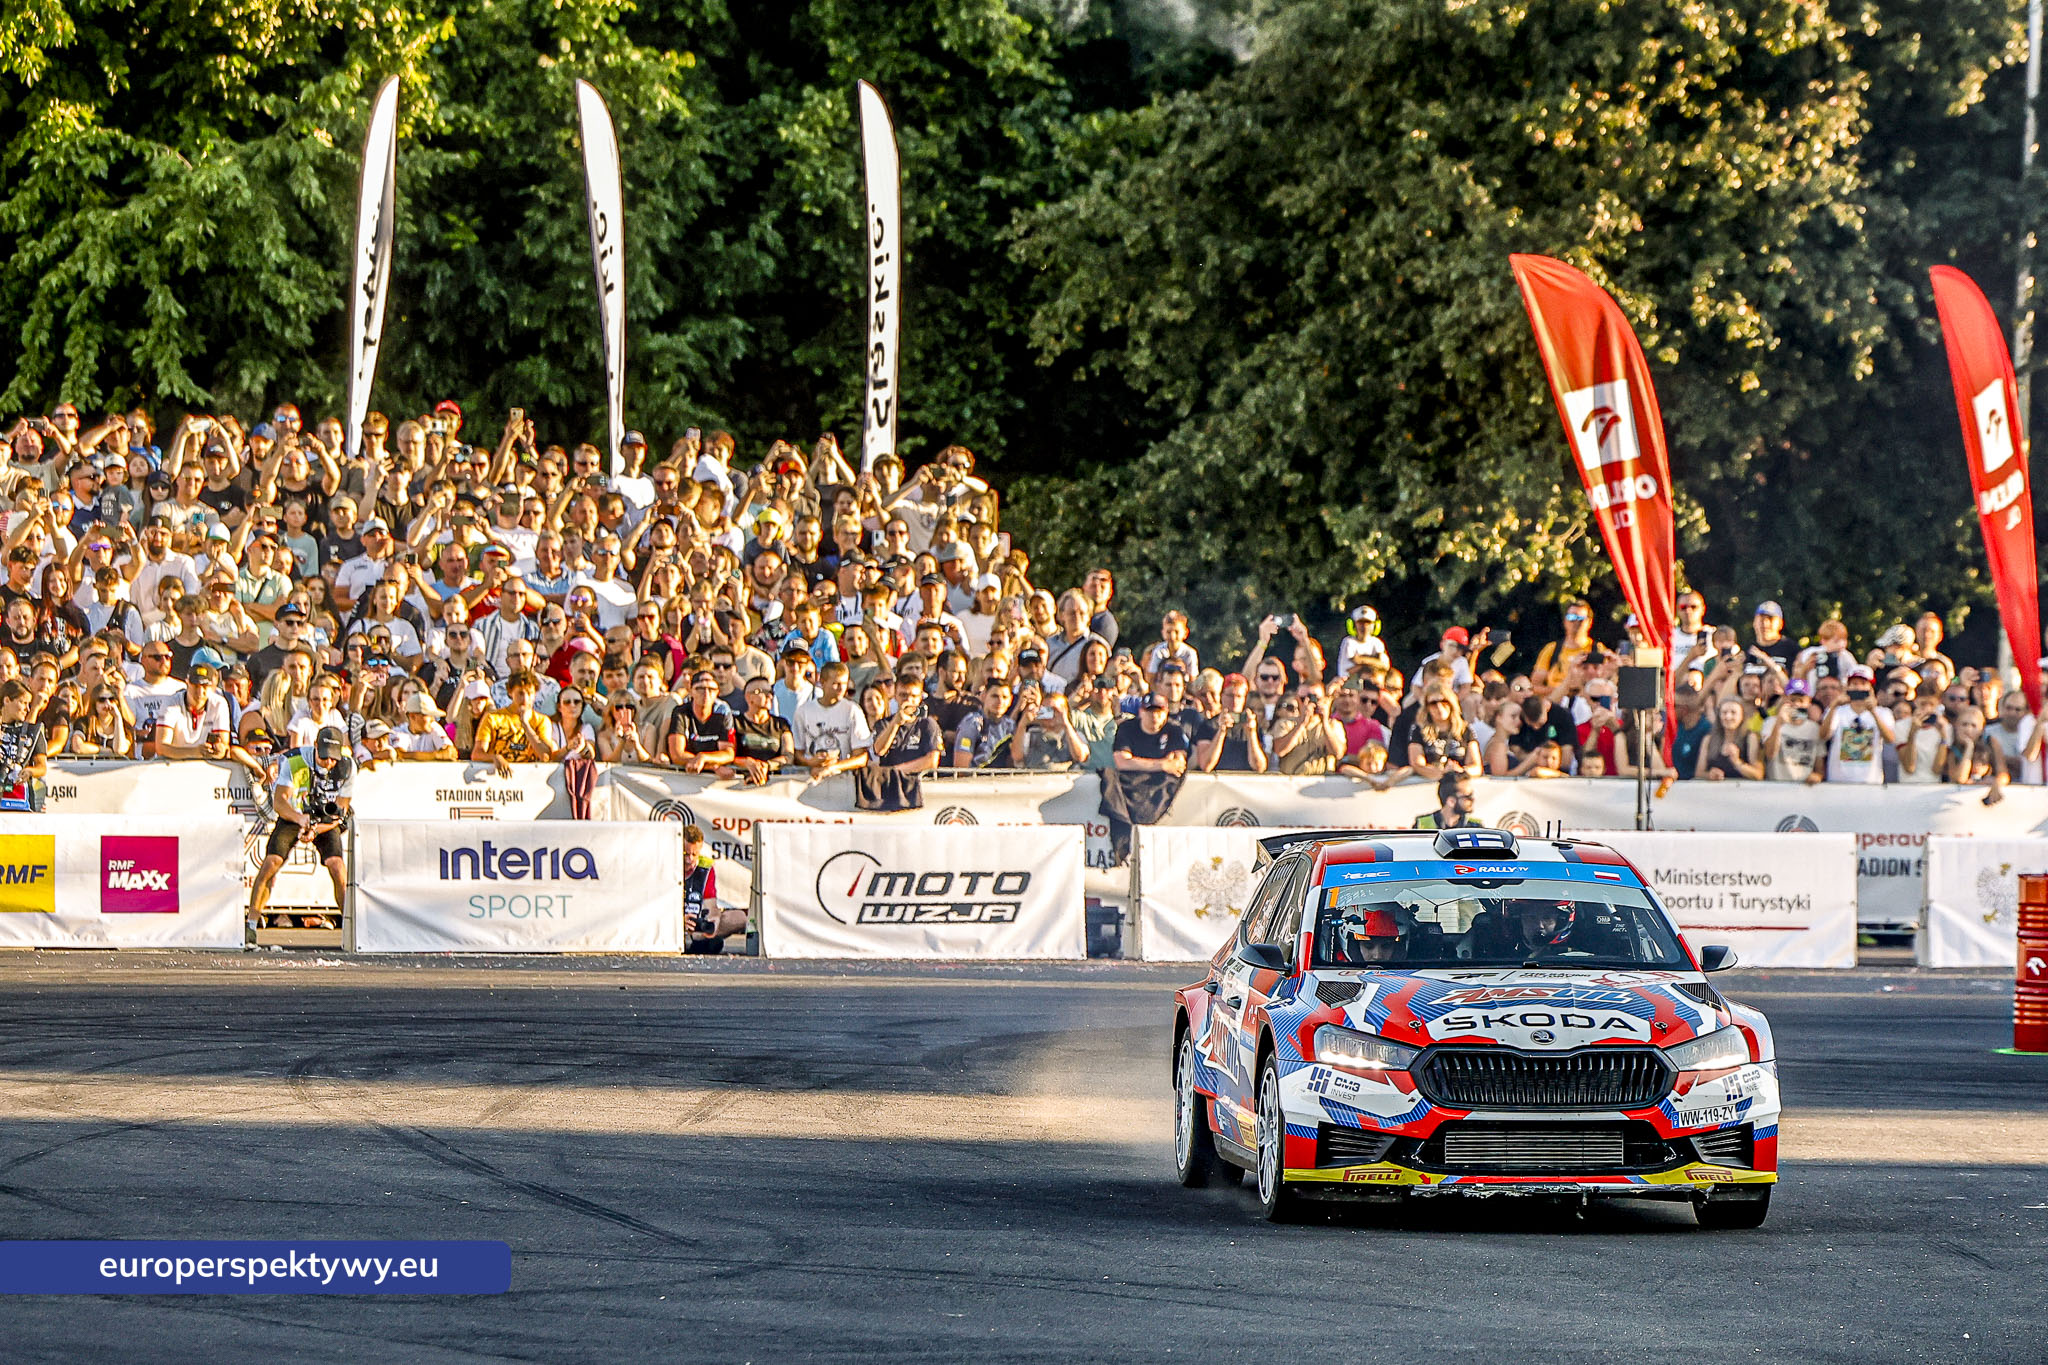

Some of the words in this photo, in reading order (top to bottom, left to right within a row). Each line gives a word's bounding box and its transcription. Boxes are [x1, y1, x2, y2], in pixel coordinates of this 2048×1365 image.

[45, 785, 77, 802] LĄSKI
[436, 789, 482, 802] STADION
[485, 786, 524, 806] ŚLĄSKI
[108, 859, 136, 871] RMF
[439, 840, 599, 880] interia
[865, 871, 1032, 897] MOTO
[1654, 868, 1773, 887] Ministerstwo
[468, 894, 574, 919] SPORT
[1328, 886, 1340, 908] 1
[1719, 892, 1725, 909] i
[1729, 892, 1812, 914] Turystyki
[858, 904, 1019, 924] WIZJA
[1438, 986, 1633, 1004] AMSOIL
[1334, 1076, 1361, 1093] CM3
[1330, 1087, 1357, 1102] INVEST
[1680, 1104, 1735, 1127] WW-119-ZY
[1343, 1168, 1403, 1182] PIRELLI
[1684, 1168, 1734, 1182] PIRELLI
